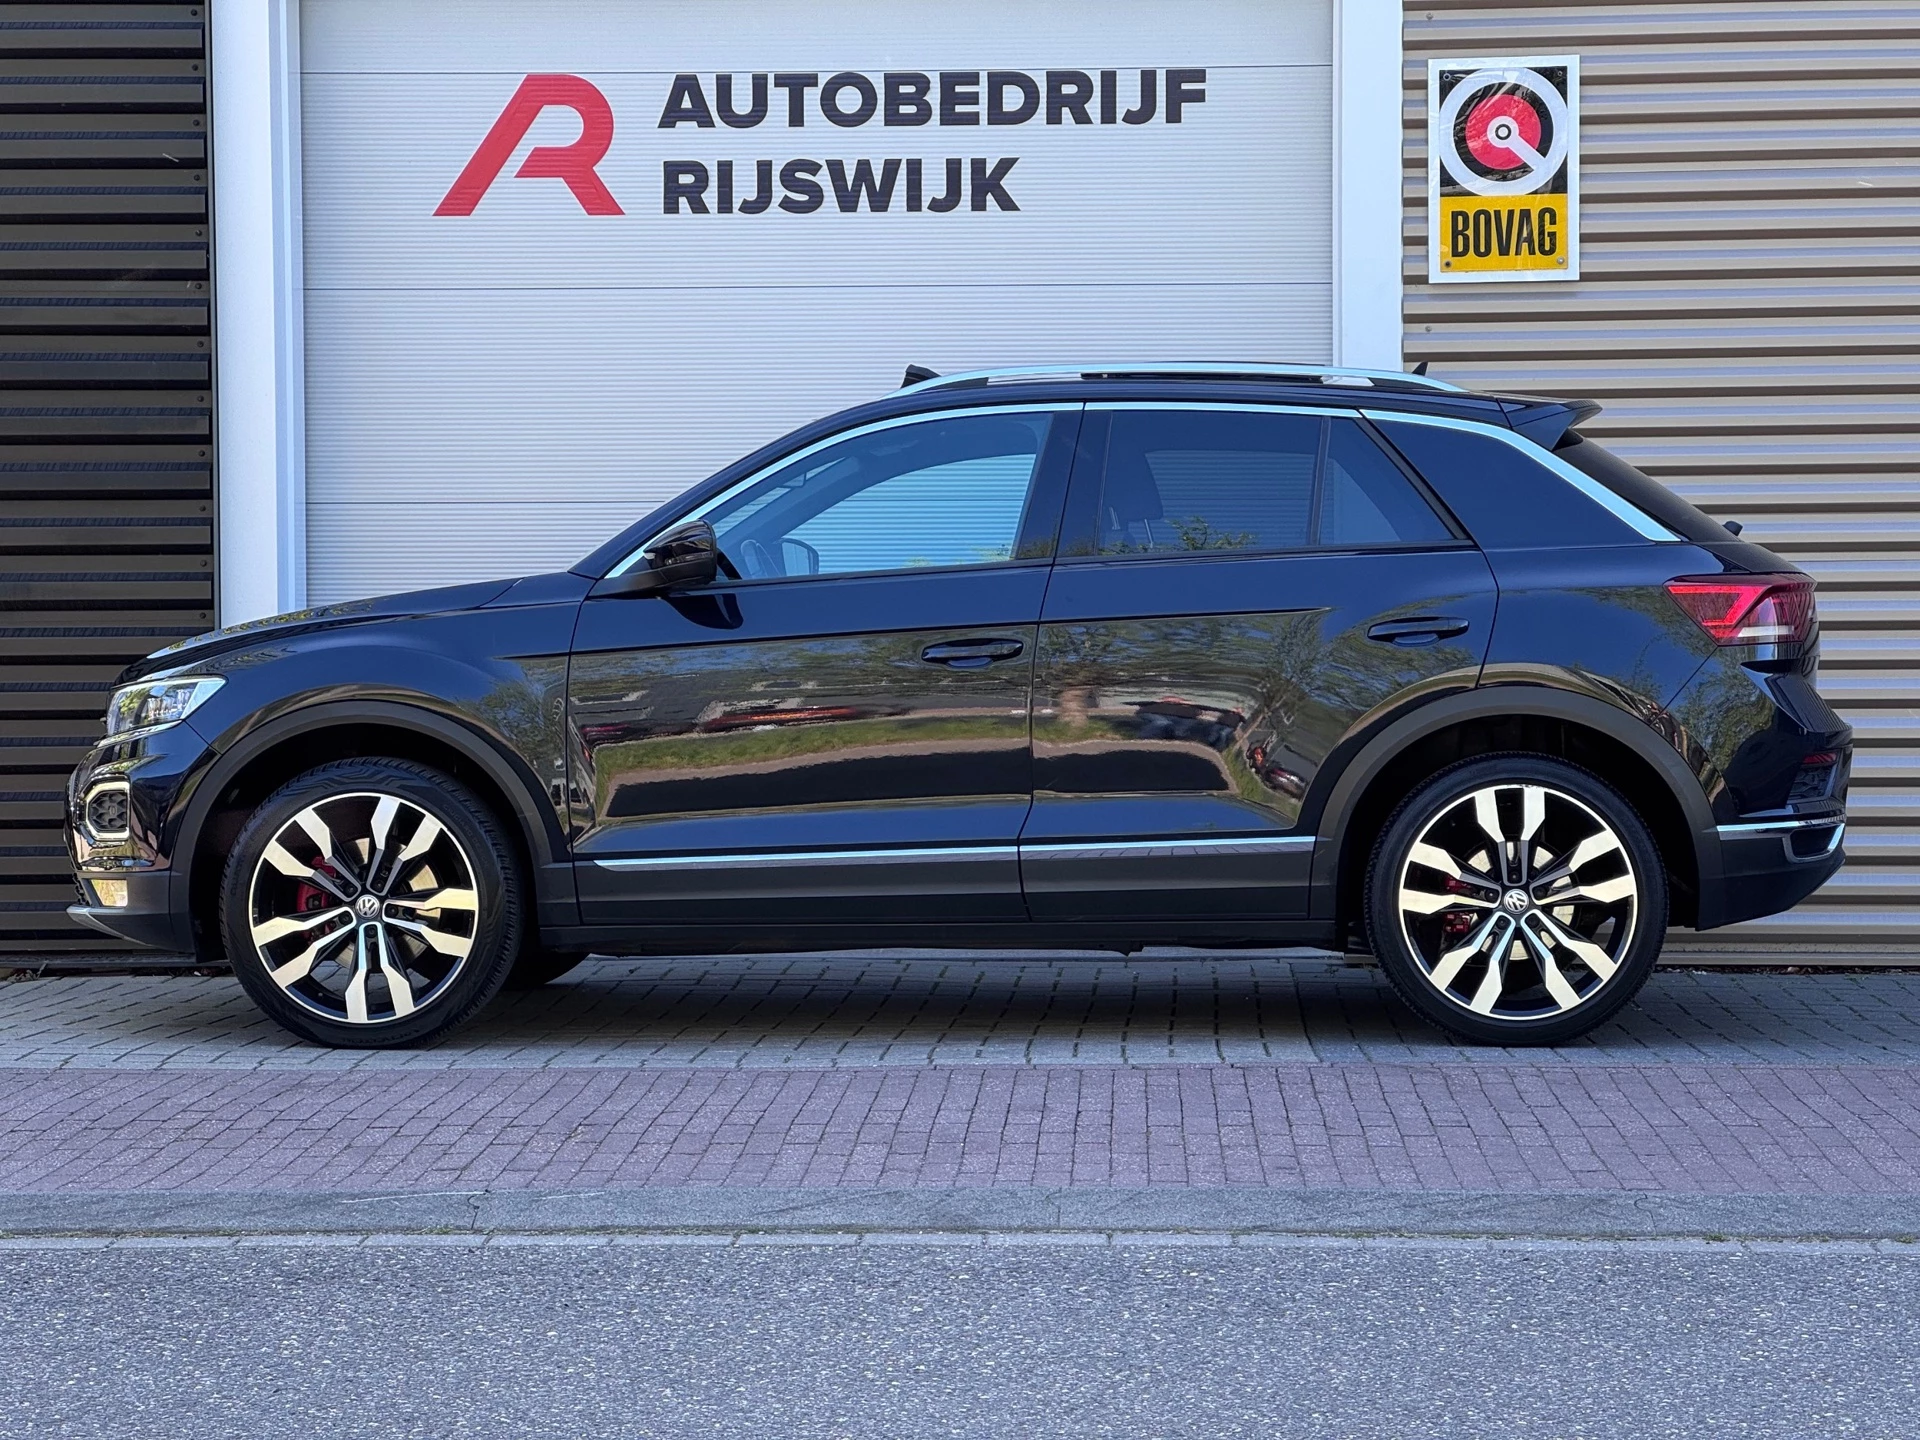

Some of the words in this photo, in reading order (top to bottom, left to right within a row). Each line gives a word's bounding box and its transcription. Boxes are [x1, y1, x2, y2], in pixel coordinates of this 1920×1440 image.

[658, 69, 1207, 129] AUTOBEDRIJF
[663, 158, 1021, 215] RIJSWIJK
[1451, 207, 1557, 258] BOVAG
